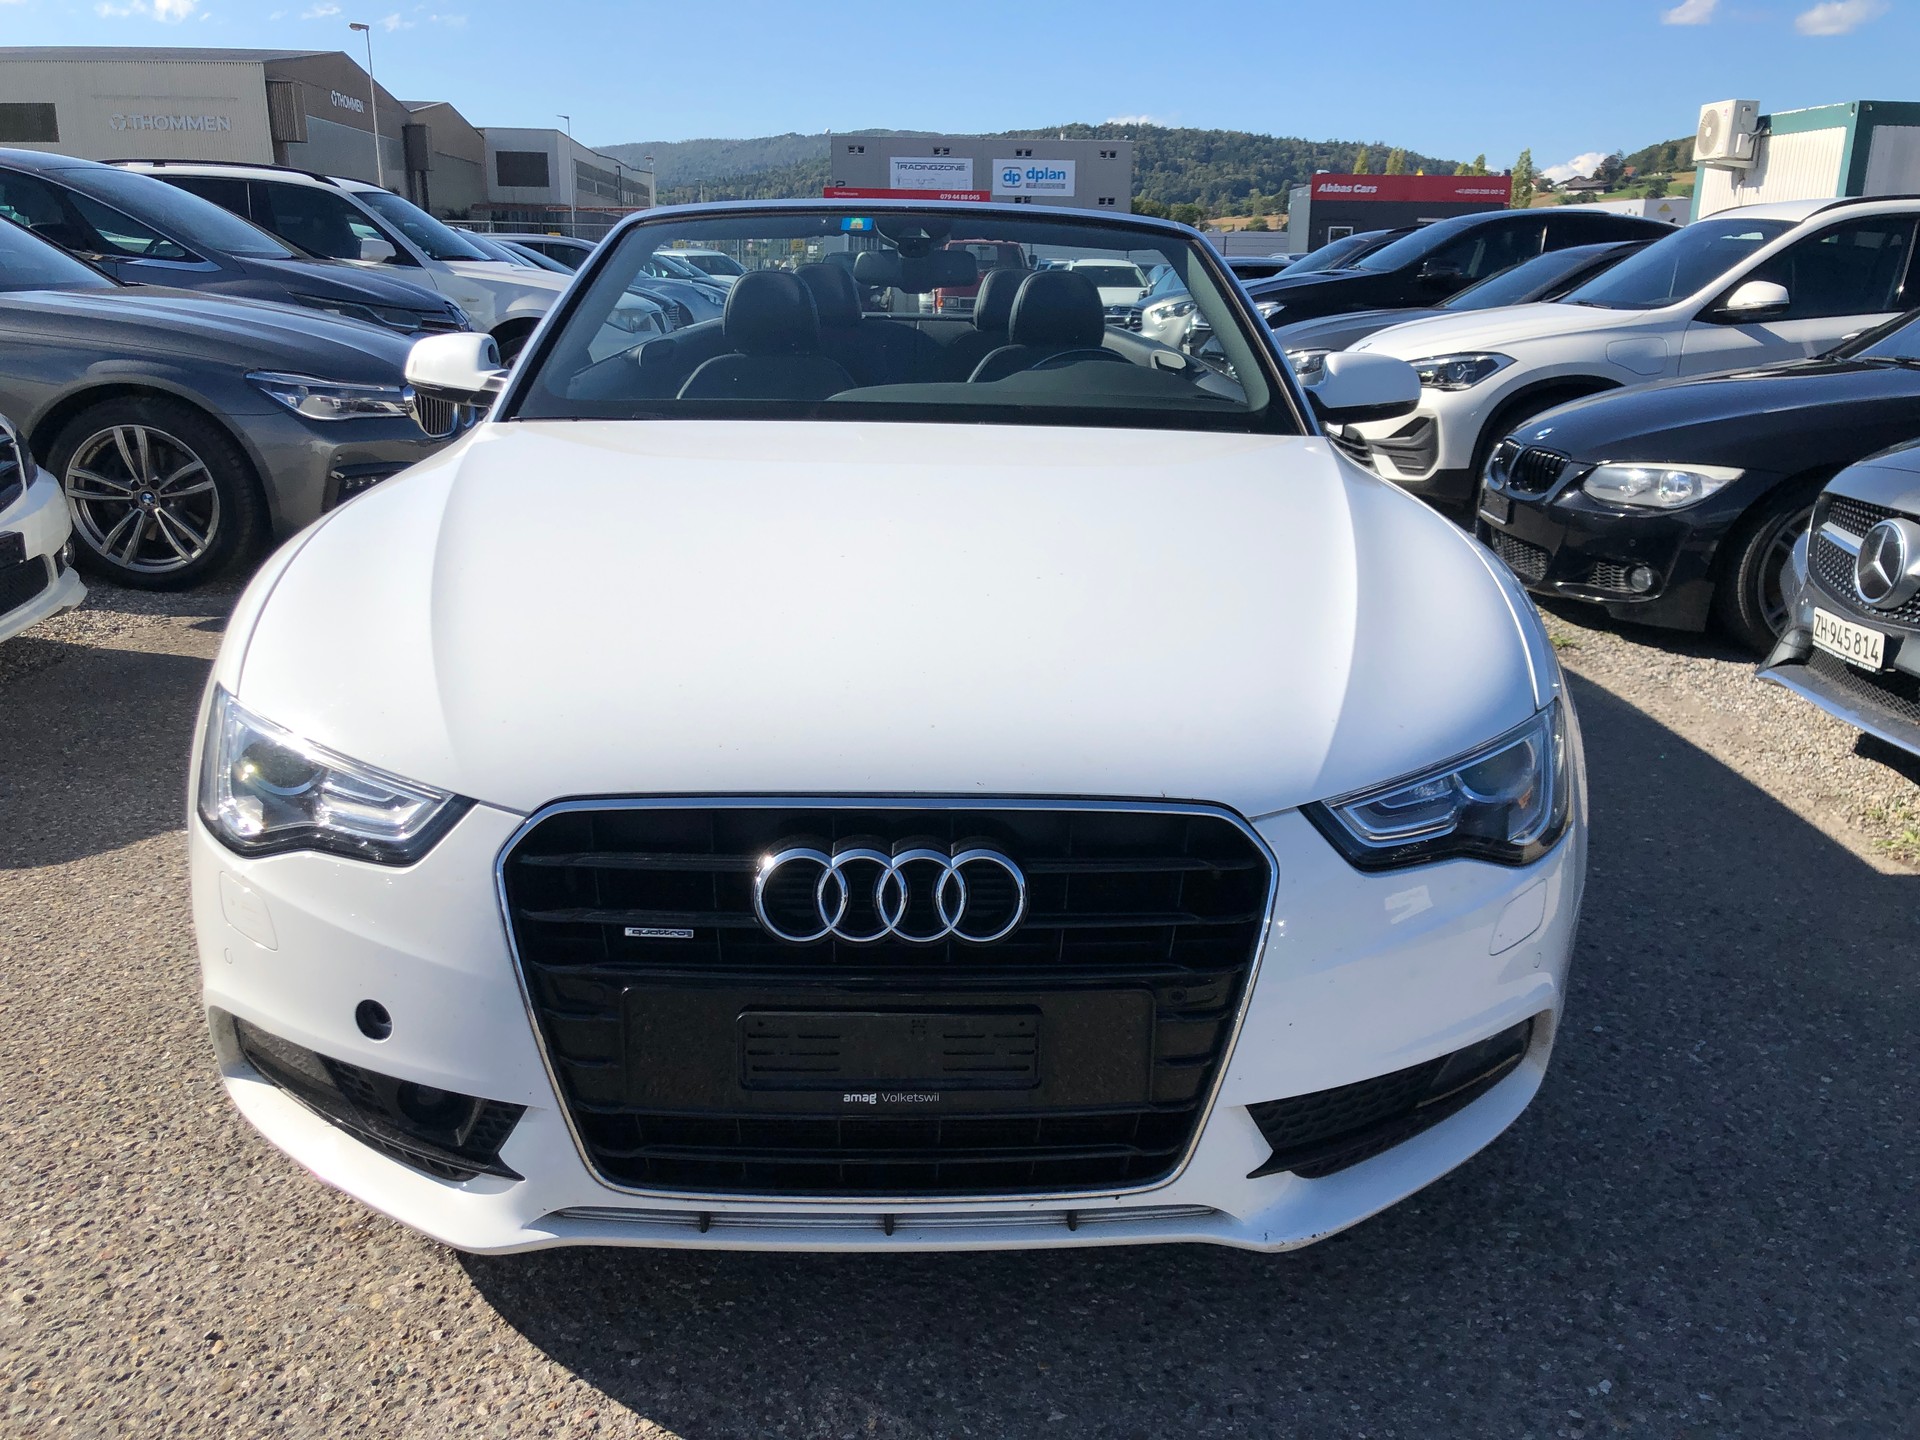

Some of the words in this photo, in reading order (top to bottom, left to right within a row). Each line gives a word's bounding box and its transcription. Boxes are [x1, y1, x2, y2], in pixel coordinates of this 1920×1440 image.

[335, 91, 365, 114] THOMMEN
[127, 113, 231, 132] THOMMEN
[895, 161, 966, 171] TRADINGZONE
[1003, 169, 1021, 185] dp
[1026, 166, 1066, 182] dplan
[1317, 183, 1353, 193] Abbas
[1353, 184, 1378, 194] Cars
[630, 928, 688, 937] quattro
[843, 1093, 877, 1105] amag
[881, 1092, 940, 1103] Volketswil
